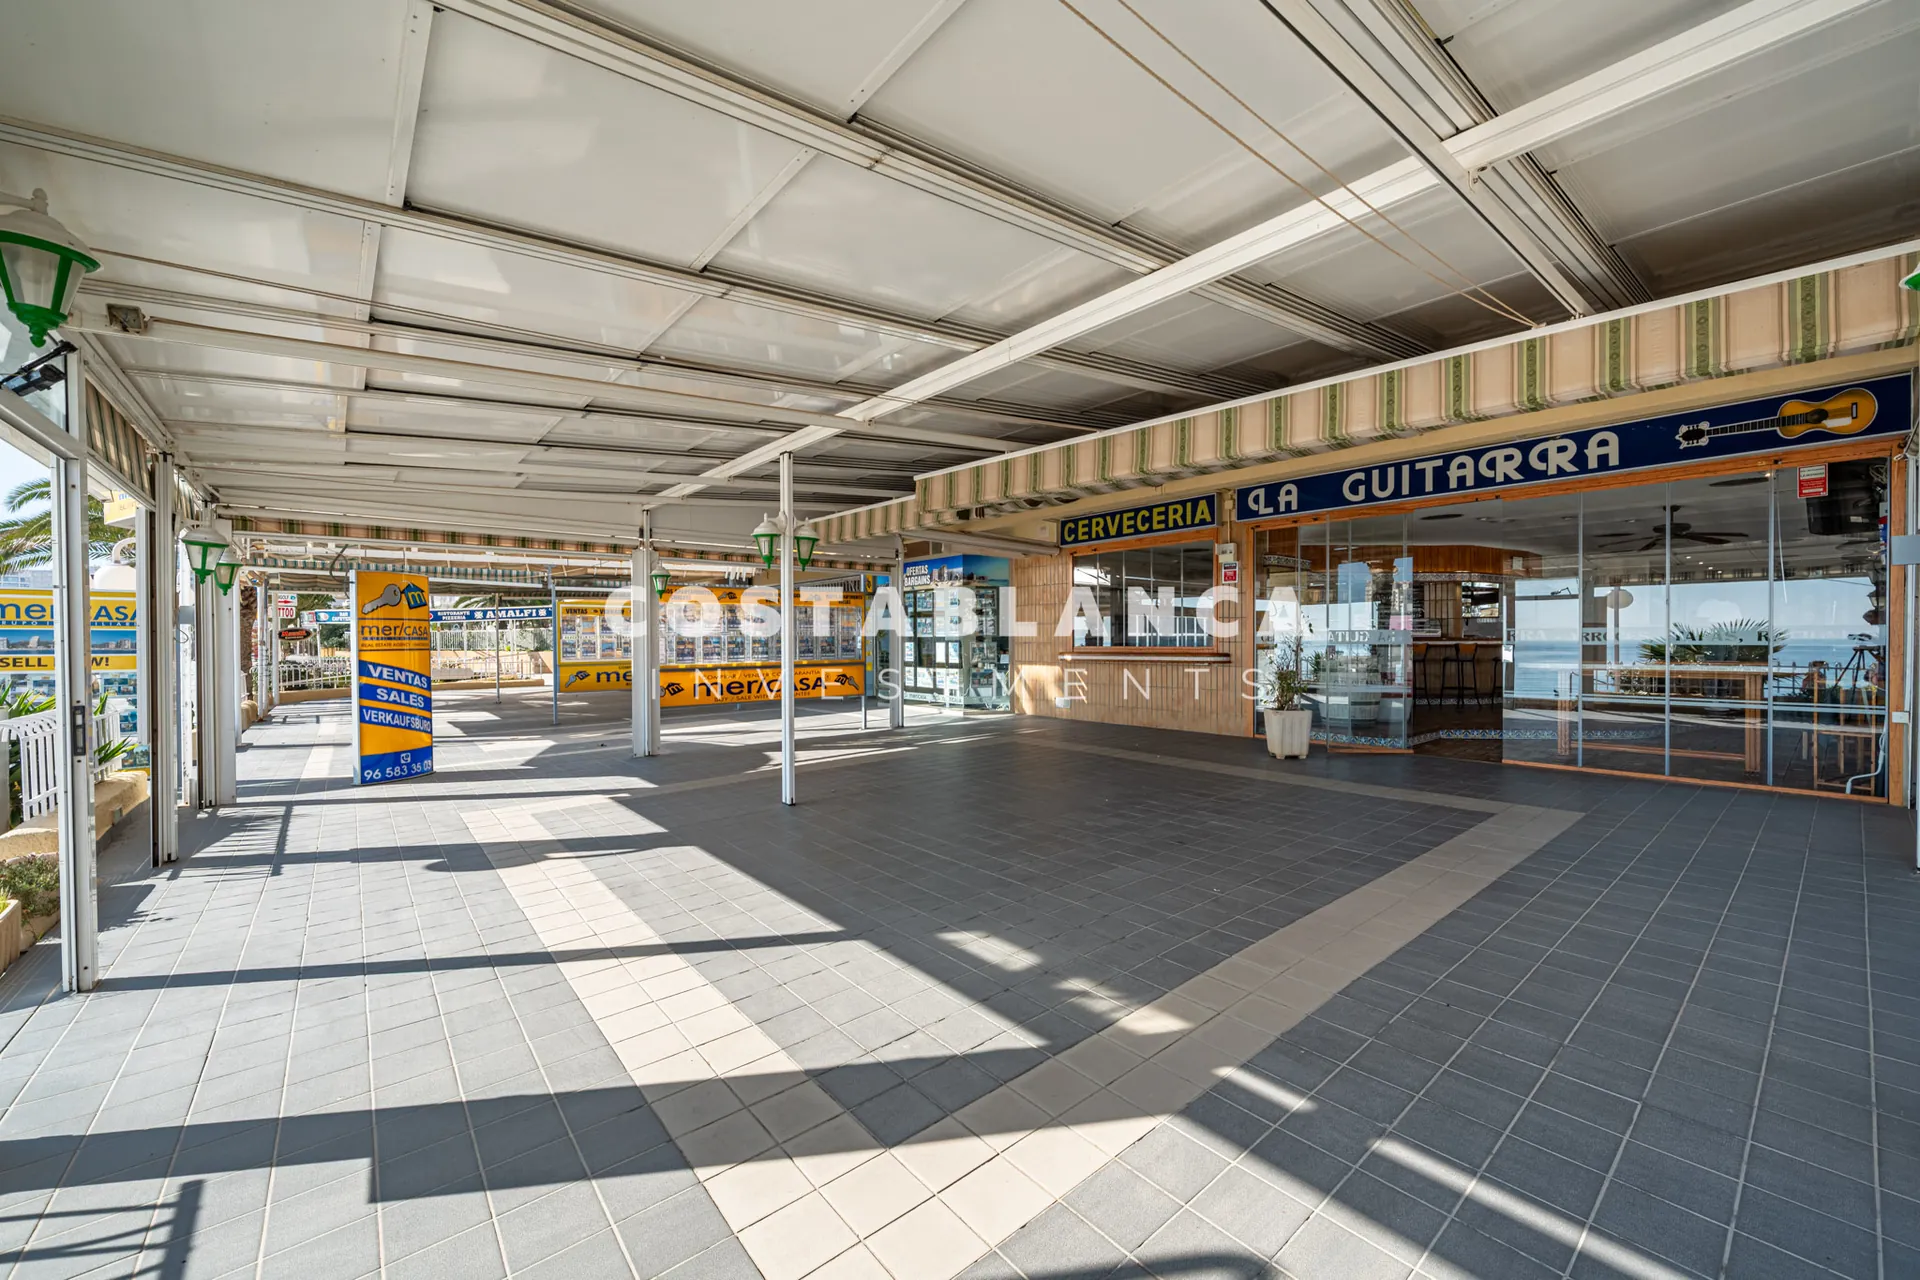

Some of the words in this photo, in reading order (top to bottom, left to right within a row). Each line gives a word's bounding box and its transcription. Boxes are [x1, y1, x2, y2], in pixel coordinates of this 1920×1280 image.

[1248, 483, 1298, 514] LA
[1342, 430, 1620, 502] GUITARRA
[1063, 499, 1212, 543] CERVECERIA
[906, 564, 929, 577] OFERTAS
[904, 575, 931, 587] BARGAINS
[486, 608, 537, 619] AMALFI
[0, 657, 48, 667] SELL
[367, 663, 428, 689] VENTAS
[376, 687, 425, 708] SALES
[362, 708, 432, 732] VERKAUFSBÜRO
[363, 768, 382, 781] 96
[385, 764, 408, 778] 583
[411, 762, 422, 773] 35
